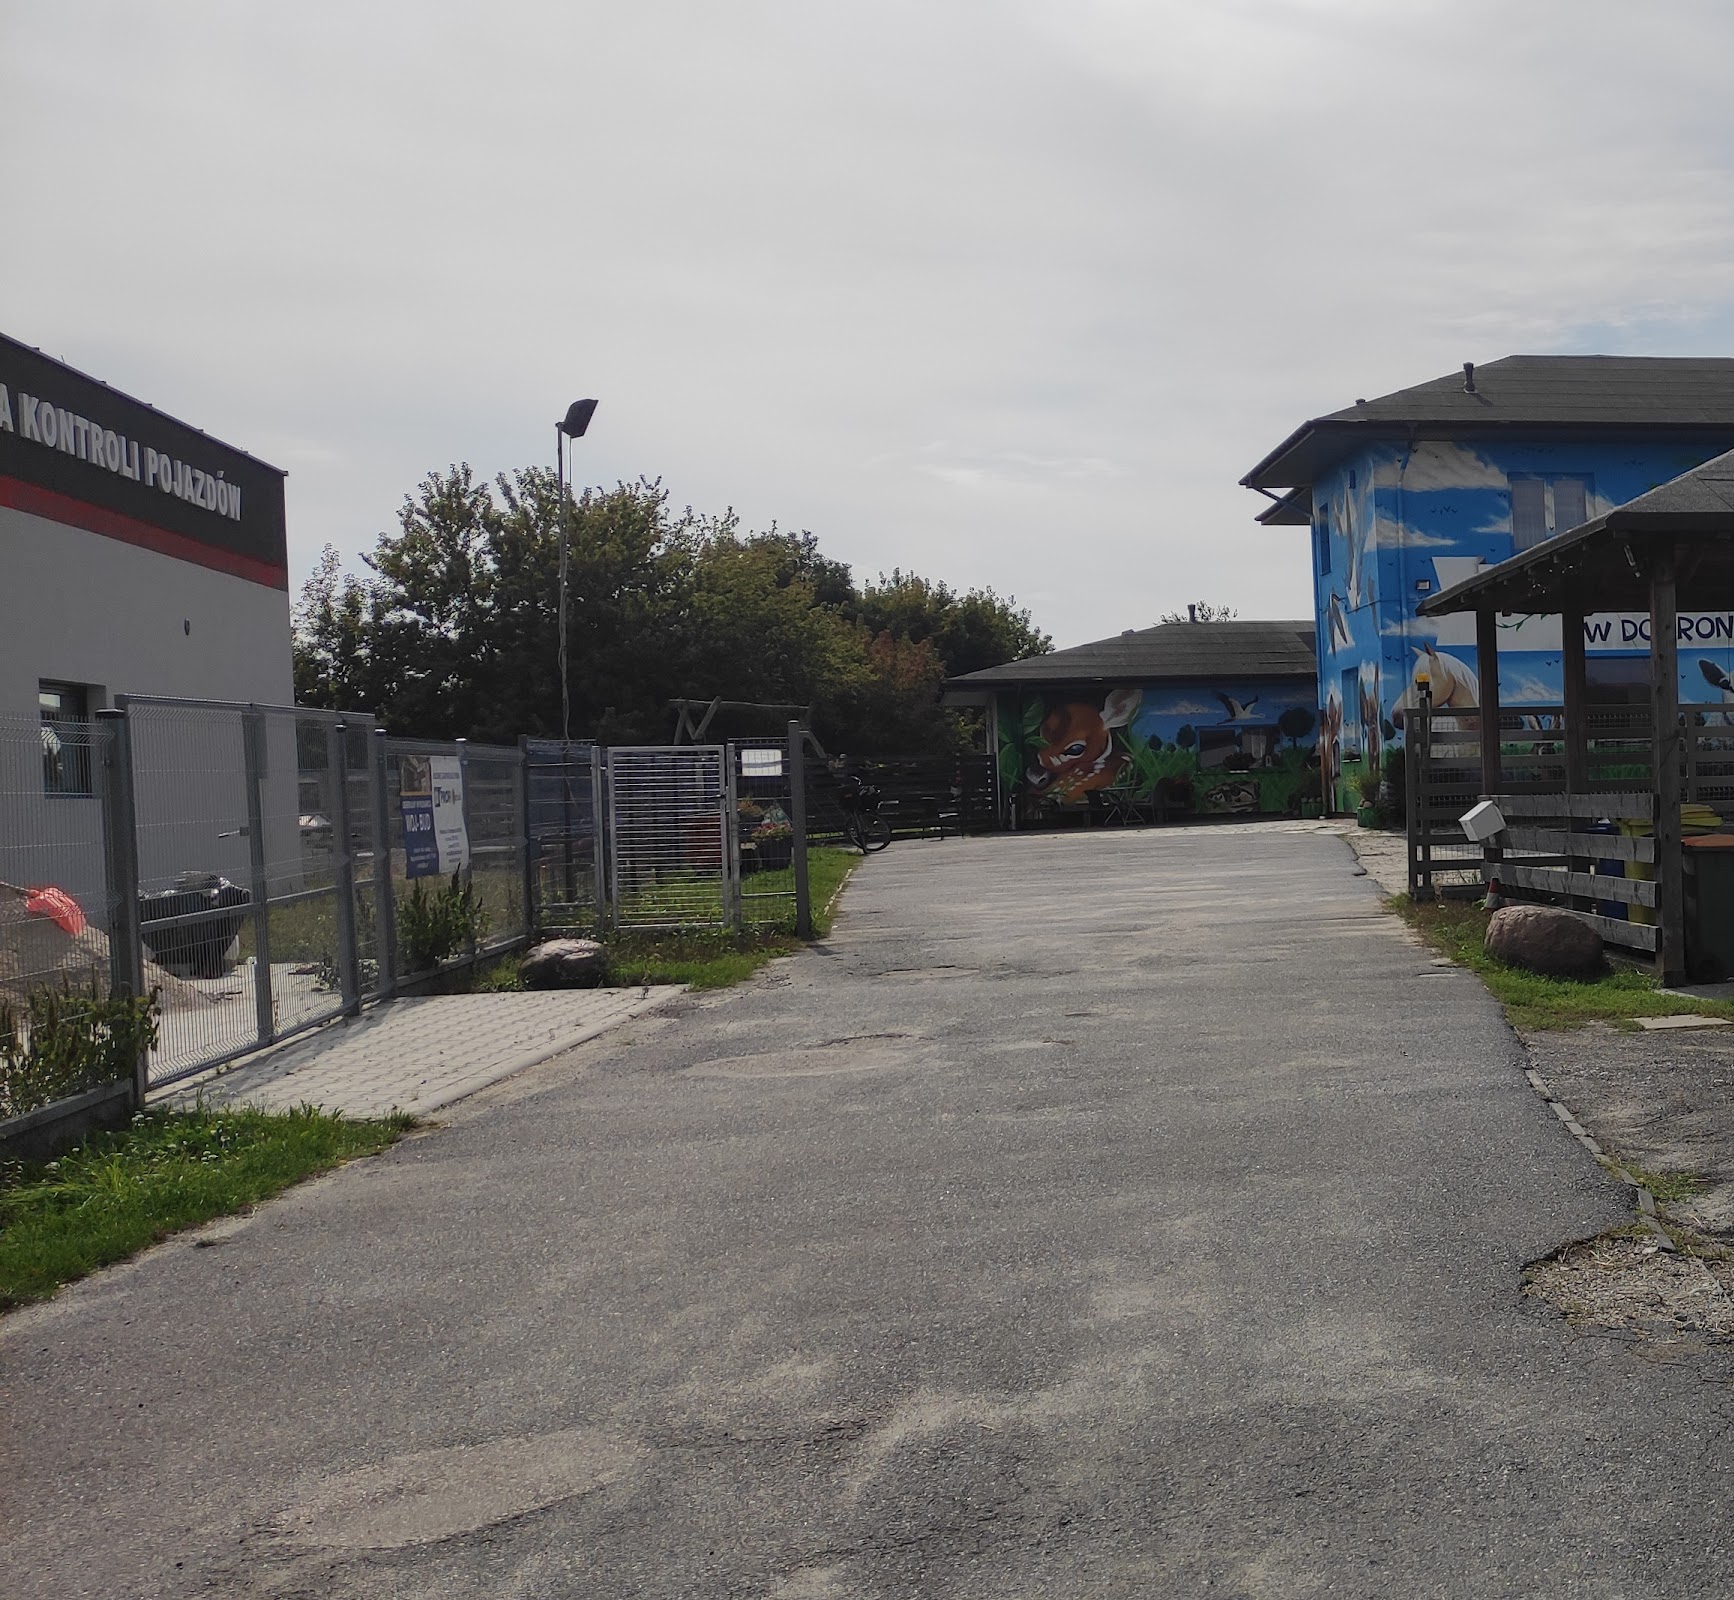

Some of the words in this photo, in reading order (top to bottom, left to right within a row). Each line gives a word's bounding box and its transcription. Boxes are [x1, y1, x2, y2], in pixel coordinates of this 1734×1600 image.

[18, 393, 140, 481] KONTROLI
[144, 447, 241, 521] POJAZDÓW
[1583, 621, 1611, 643] W
